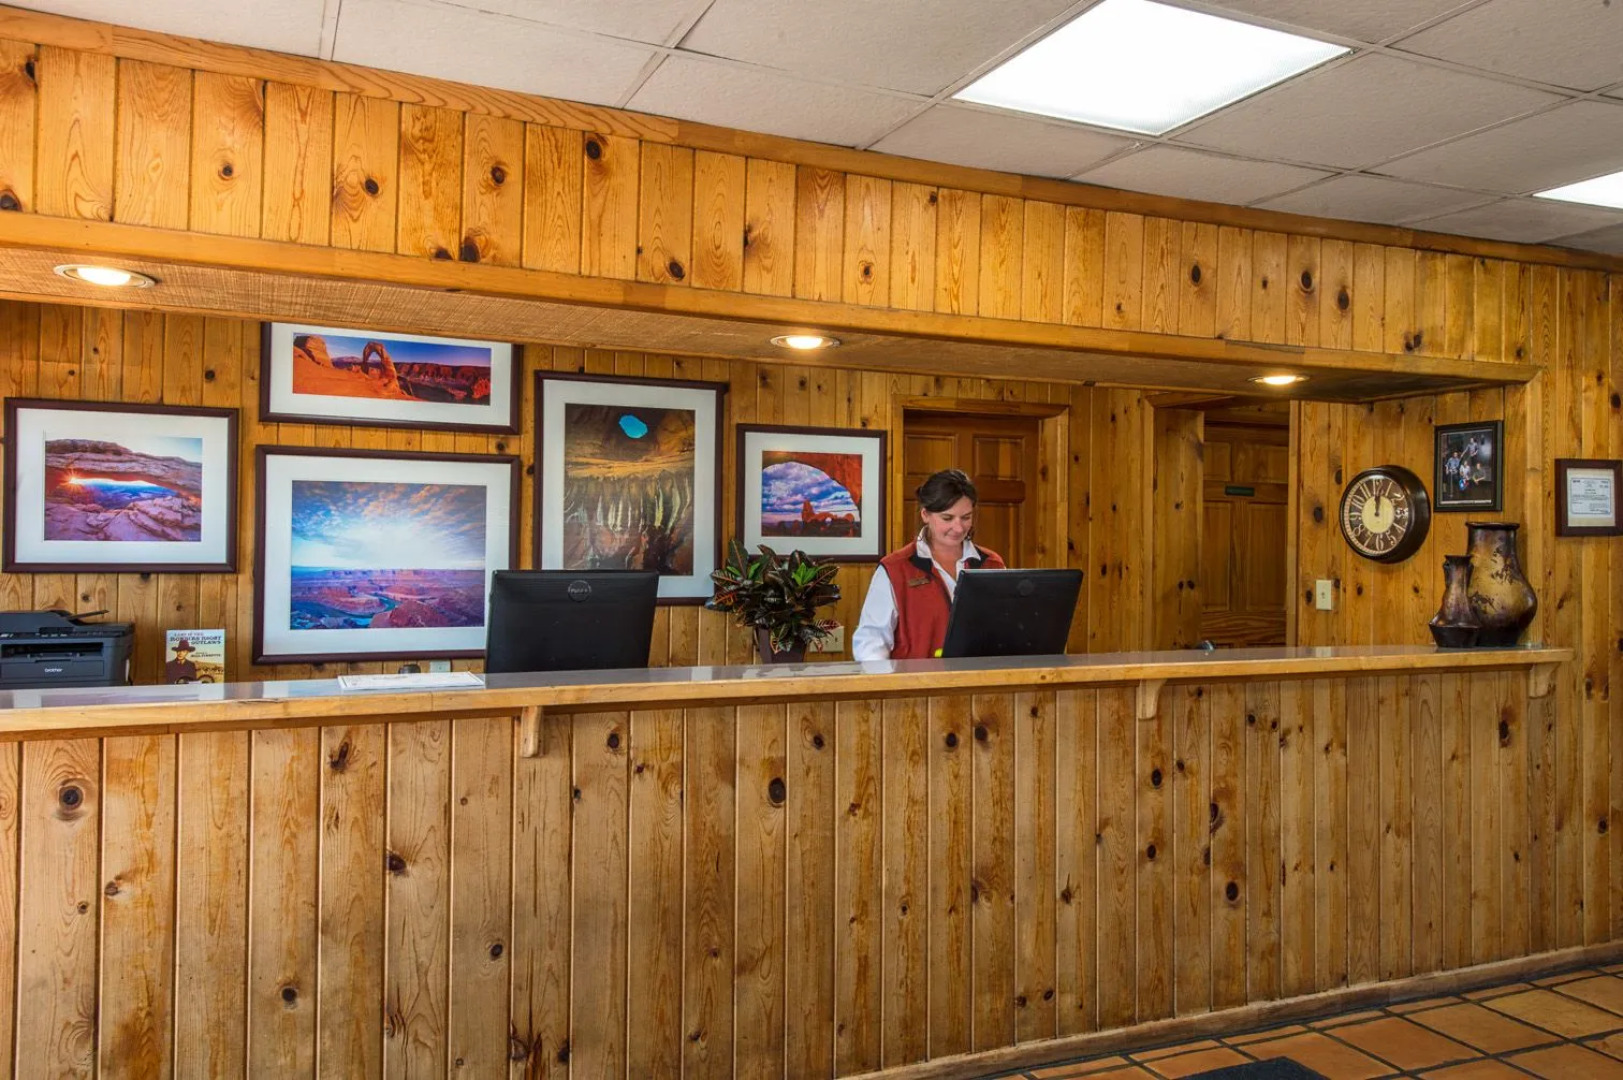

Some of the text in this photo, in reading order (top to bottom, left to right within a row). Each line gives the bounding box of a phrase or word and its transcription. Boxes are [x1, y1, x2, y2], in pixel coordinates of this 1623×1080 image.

[1350, 494, 1366, 510] 10
[1349, 512, 1362, 521] 9
[1353, 523, 1364, 537] 8
[1385, 530, 1397, 546] 5
[1375, 534, 1384, 551] 6
